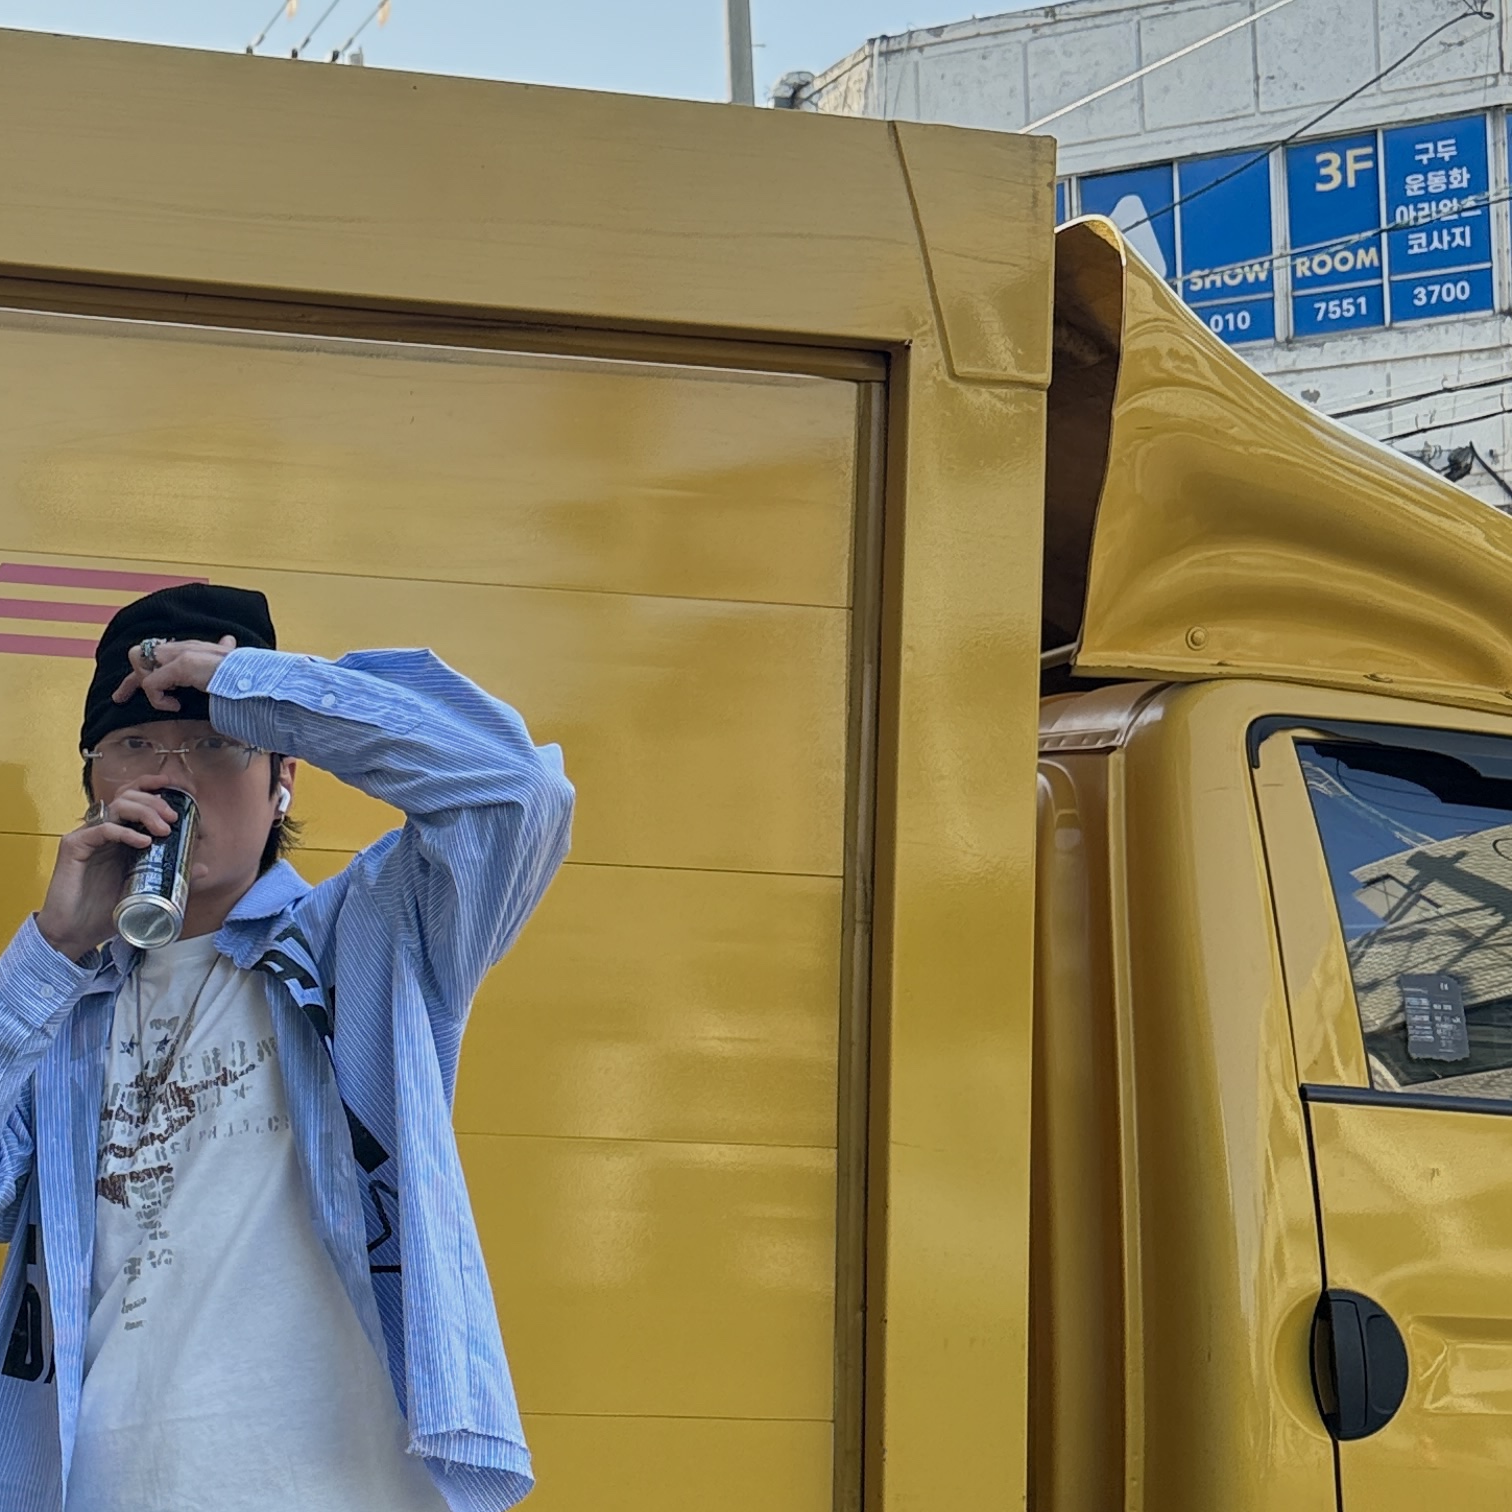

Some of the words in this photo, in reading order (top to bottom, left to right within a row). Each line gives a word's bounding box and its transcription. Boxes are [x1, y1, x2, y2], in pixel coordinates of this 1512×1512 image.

[1315, 146, 1374, 193] 3F
[1414, 139, 1458, 164] 구두
[1404, 167, 1471, 196] 운동화
[1407, 225, 1472, 255] 코사지
[1189, 261, 1270, 292] SHOW
[1295, 246, 1380, 279] ROOM
[1209, 310, 1251, 333] 010
[1313, 296, 1368, 322] 7551
[1413, 280, 1471, 306] 3700
